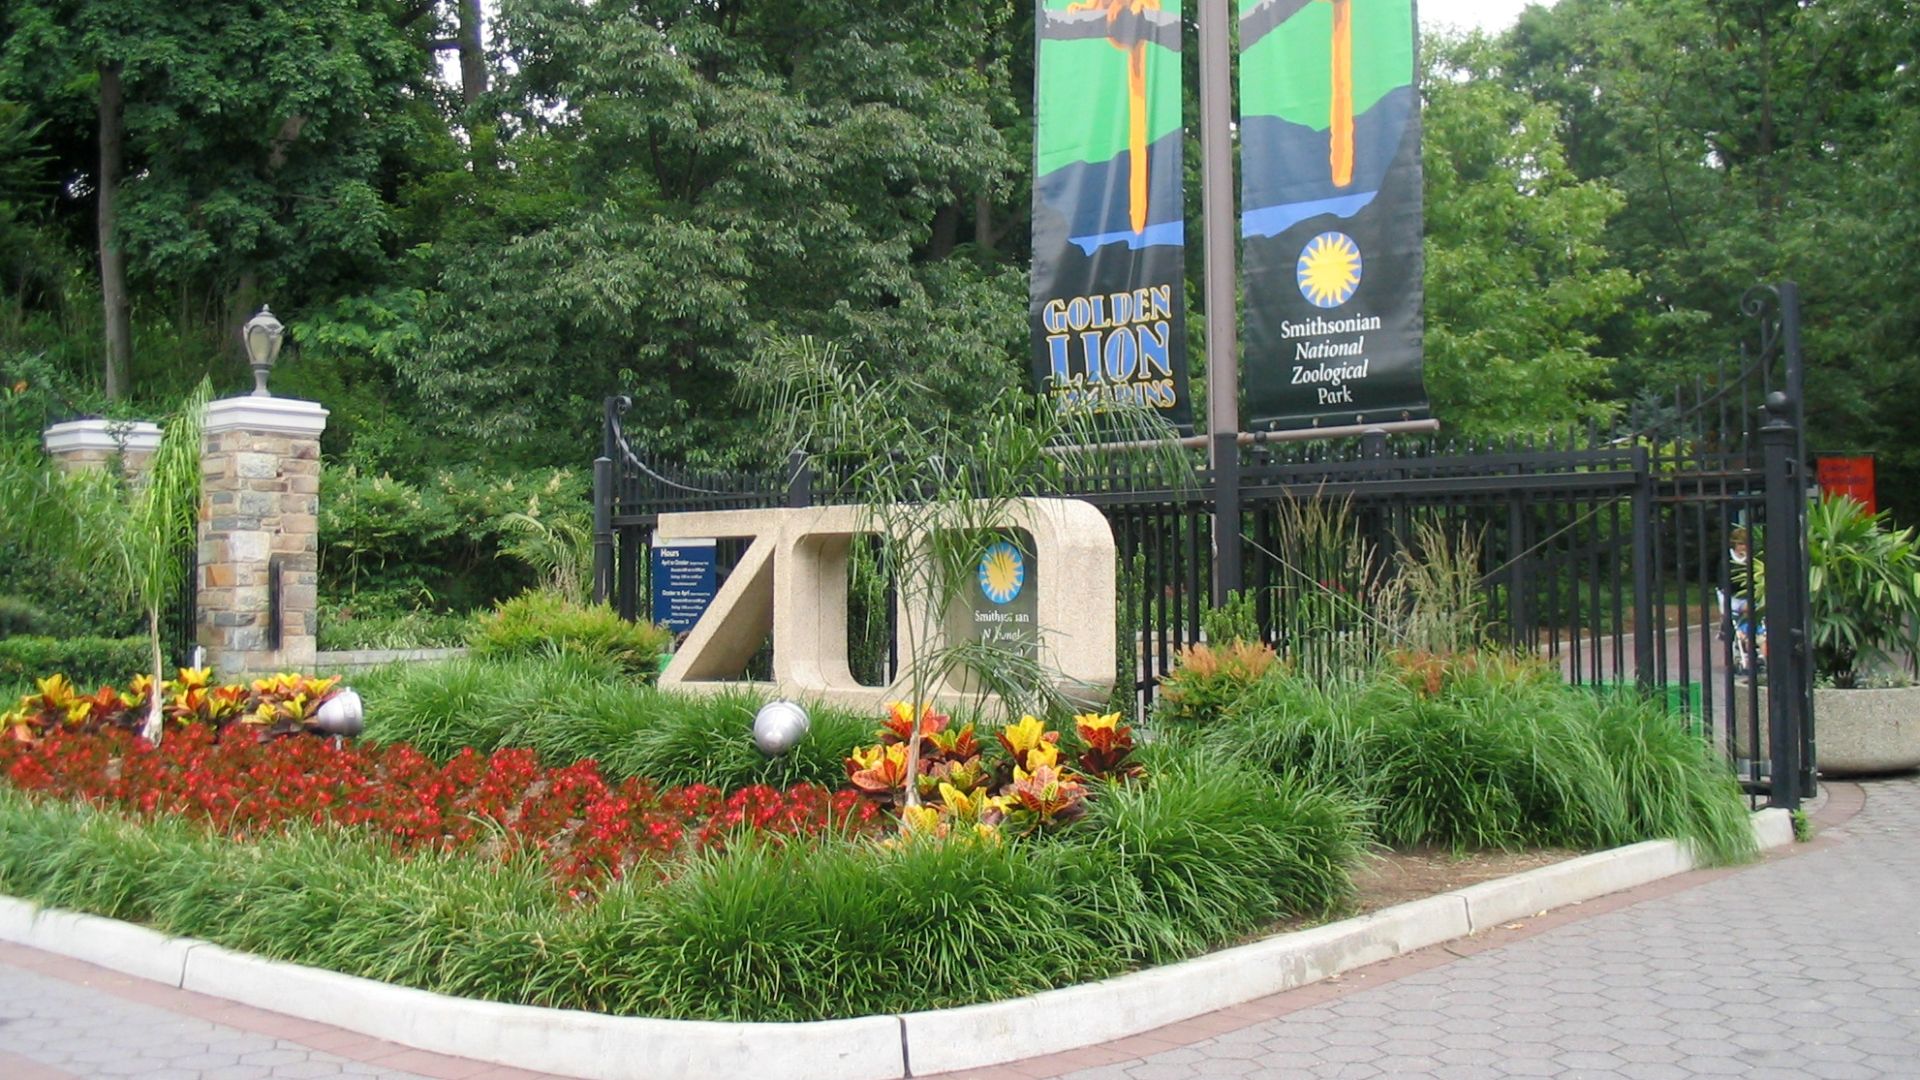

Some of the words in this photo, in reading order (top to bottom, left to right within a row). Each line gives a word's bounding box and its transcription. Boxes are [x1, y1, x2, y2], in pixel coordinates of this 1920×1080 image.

[1043, 284, 1172, 333] GOLDEN
[1281, 313, 1381, 339] Smithsonian
[1046, 320, 1173, 386] LION
[1295, 335, 1364, 361] National
[1291, 359, 1369, 386] Zoological
[1050, 378, 1177, 418] RINS
[1318, 385, 1353, 405] Park
[661, 549, 680, 558] Hours
[657, 498, 1117, 708] ZOO
